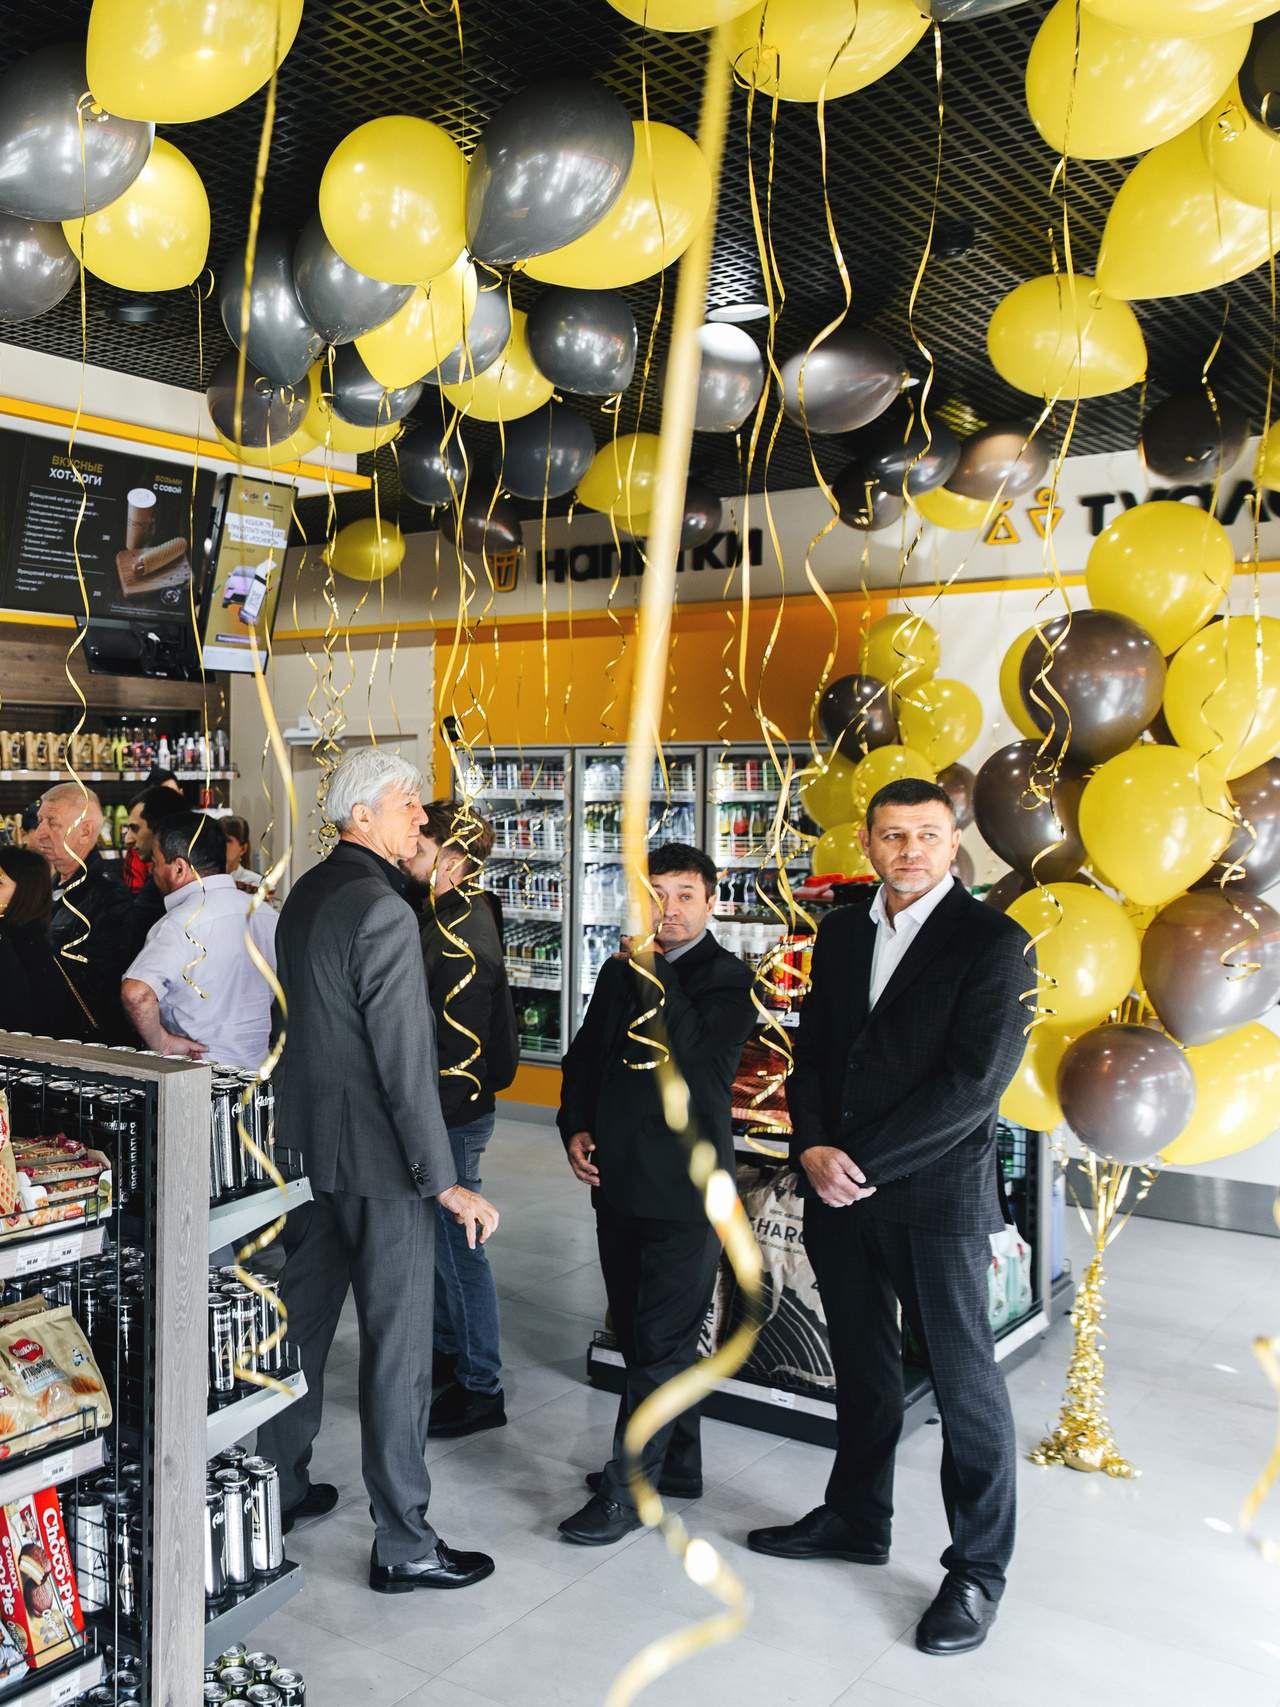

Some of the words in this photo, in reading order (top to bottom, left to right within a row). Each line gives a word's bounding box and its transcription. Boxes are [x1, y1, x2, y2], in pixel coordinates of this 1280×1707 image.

[51, 453, 103, 474] ВКУСНЫЕ
[152, 483, 159, 491] С
[159, 483, 183, 495] СОБОЙ
